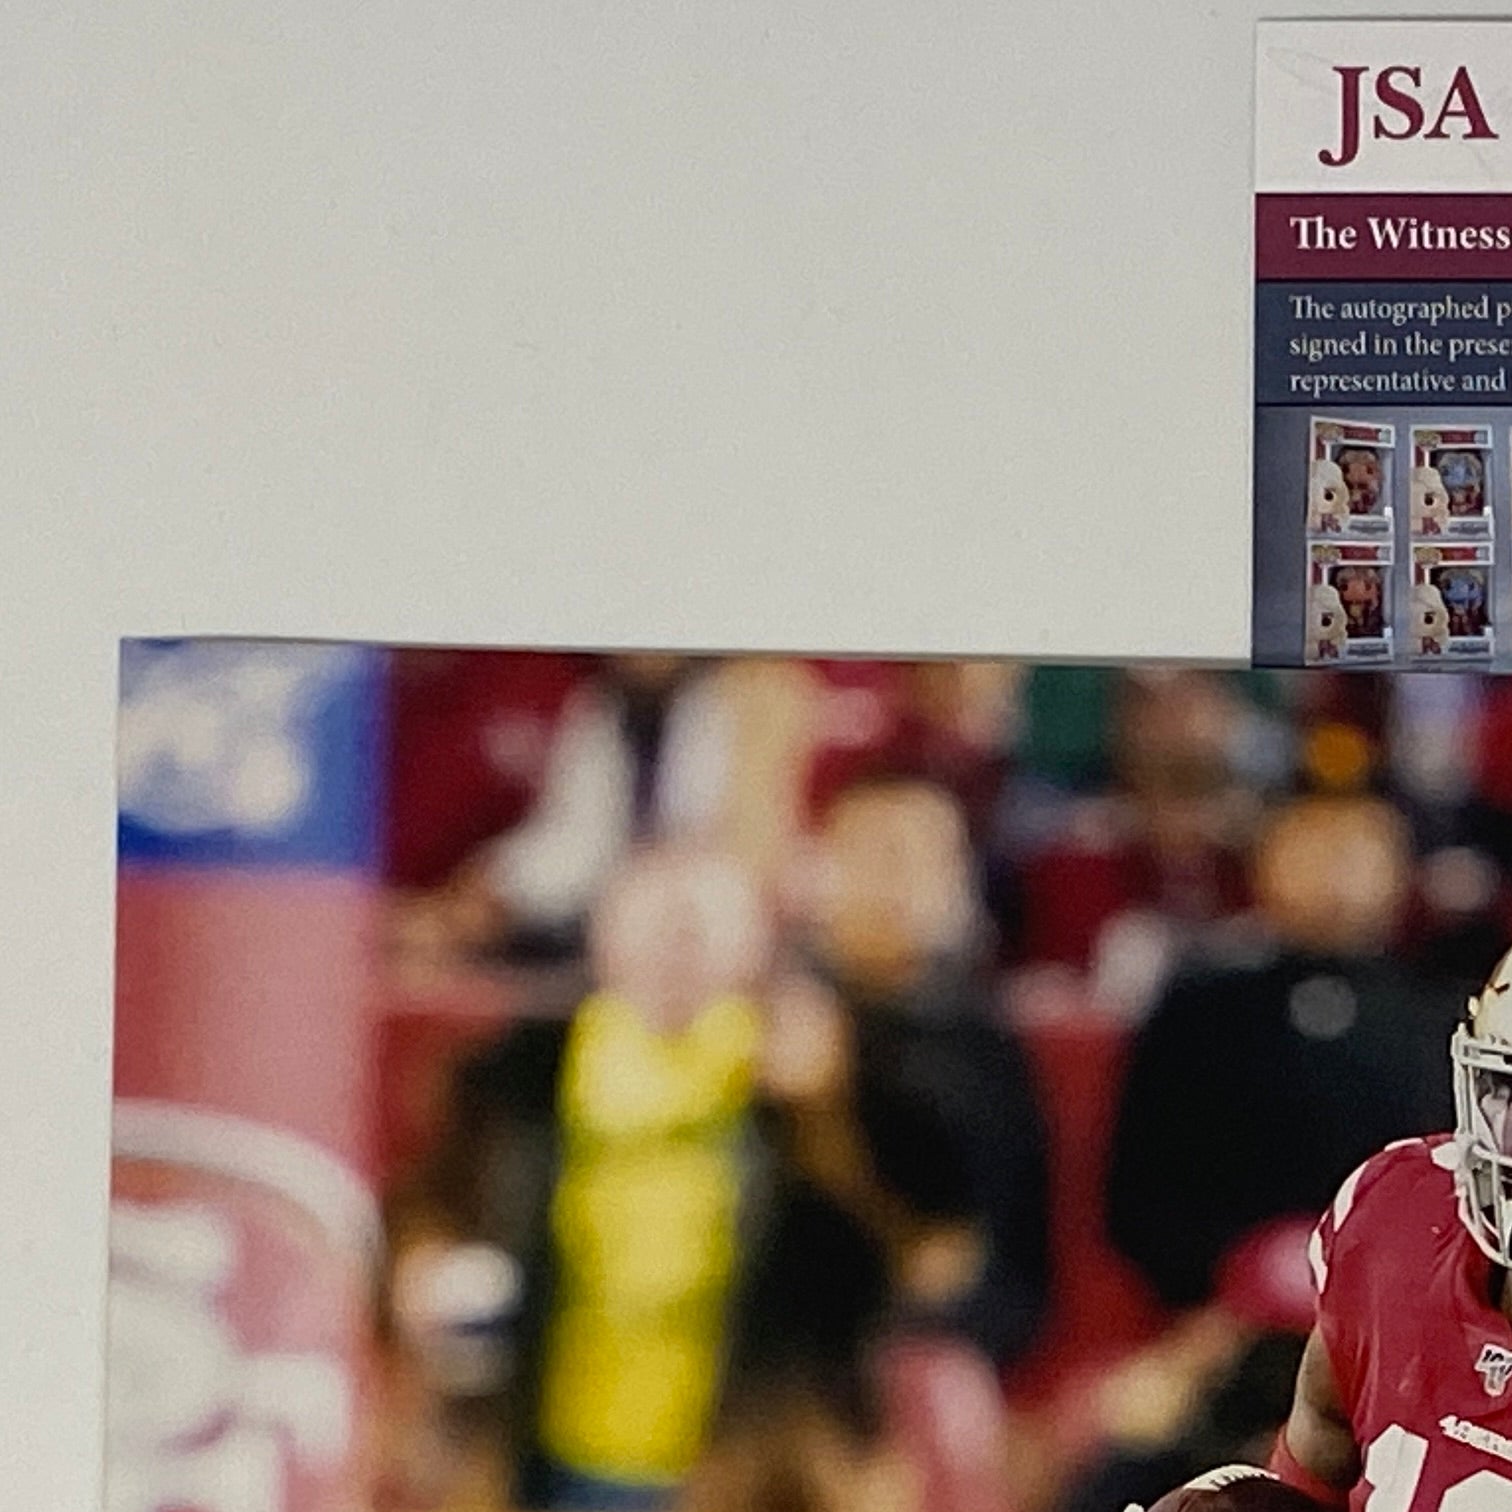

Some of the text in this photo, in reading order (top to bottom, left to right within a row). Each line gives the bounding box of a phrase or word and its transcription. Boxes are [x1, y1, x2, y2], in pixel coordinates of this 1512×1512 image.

[1318, 65, 1500, 167] JSA
[1289, 215, 1358, 250] The
[1290, 295, 1335, 320] The
[1340, 295, 1489, 327] autographed
[1289, 331, 1367, 362] signed
[1373, 332, 1398, 355] in
[1404, 332, 1444, 356] the
[1289, 368, 1456, 399] representative
[1461, 368, 1506, 392] and
